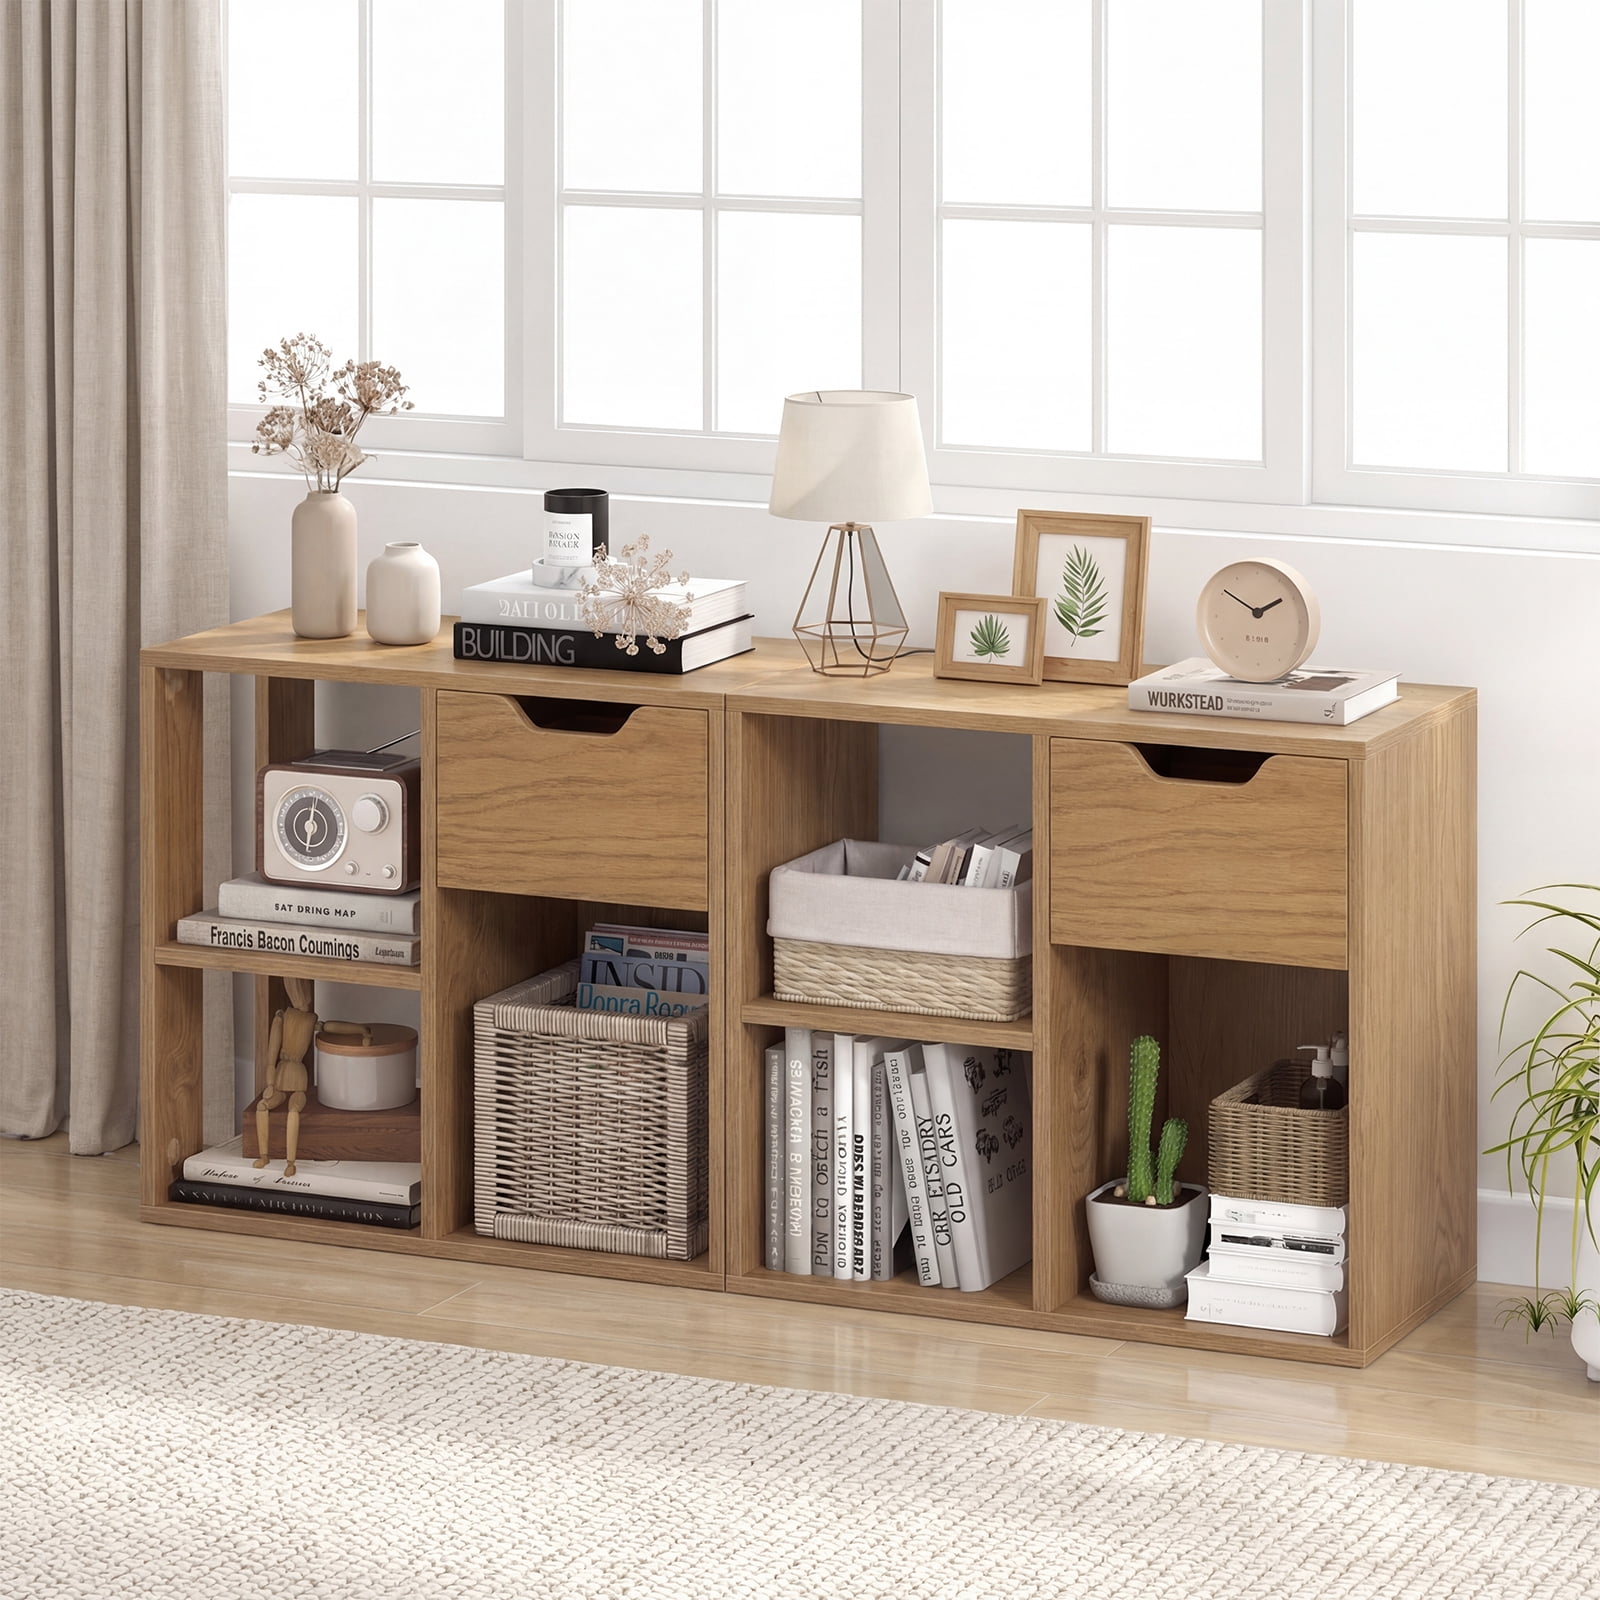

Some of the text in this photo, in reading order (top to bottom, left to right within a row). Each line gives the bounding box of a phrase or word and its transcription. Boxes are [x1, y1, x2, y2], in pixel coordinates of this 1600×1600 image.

[462, 627, 575, 664] BUILDING
[1147, 690, 1224, 711] WURKSTEAD
[274, 903, 356, 918] SAT DRING MAP
[210, 926, 360, 960] Francis Bacon Coumings
[935, 1113, 966, 1224] OLD CARS
